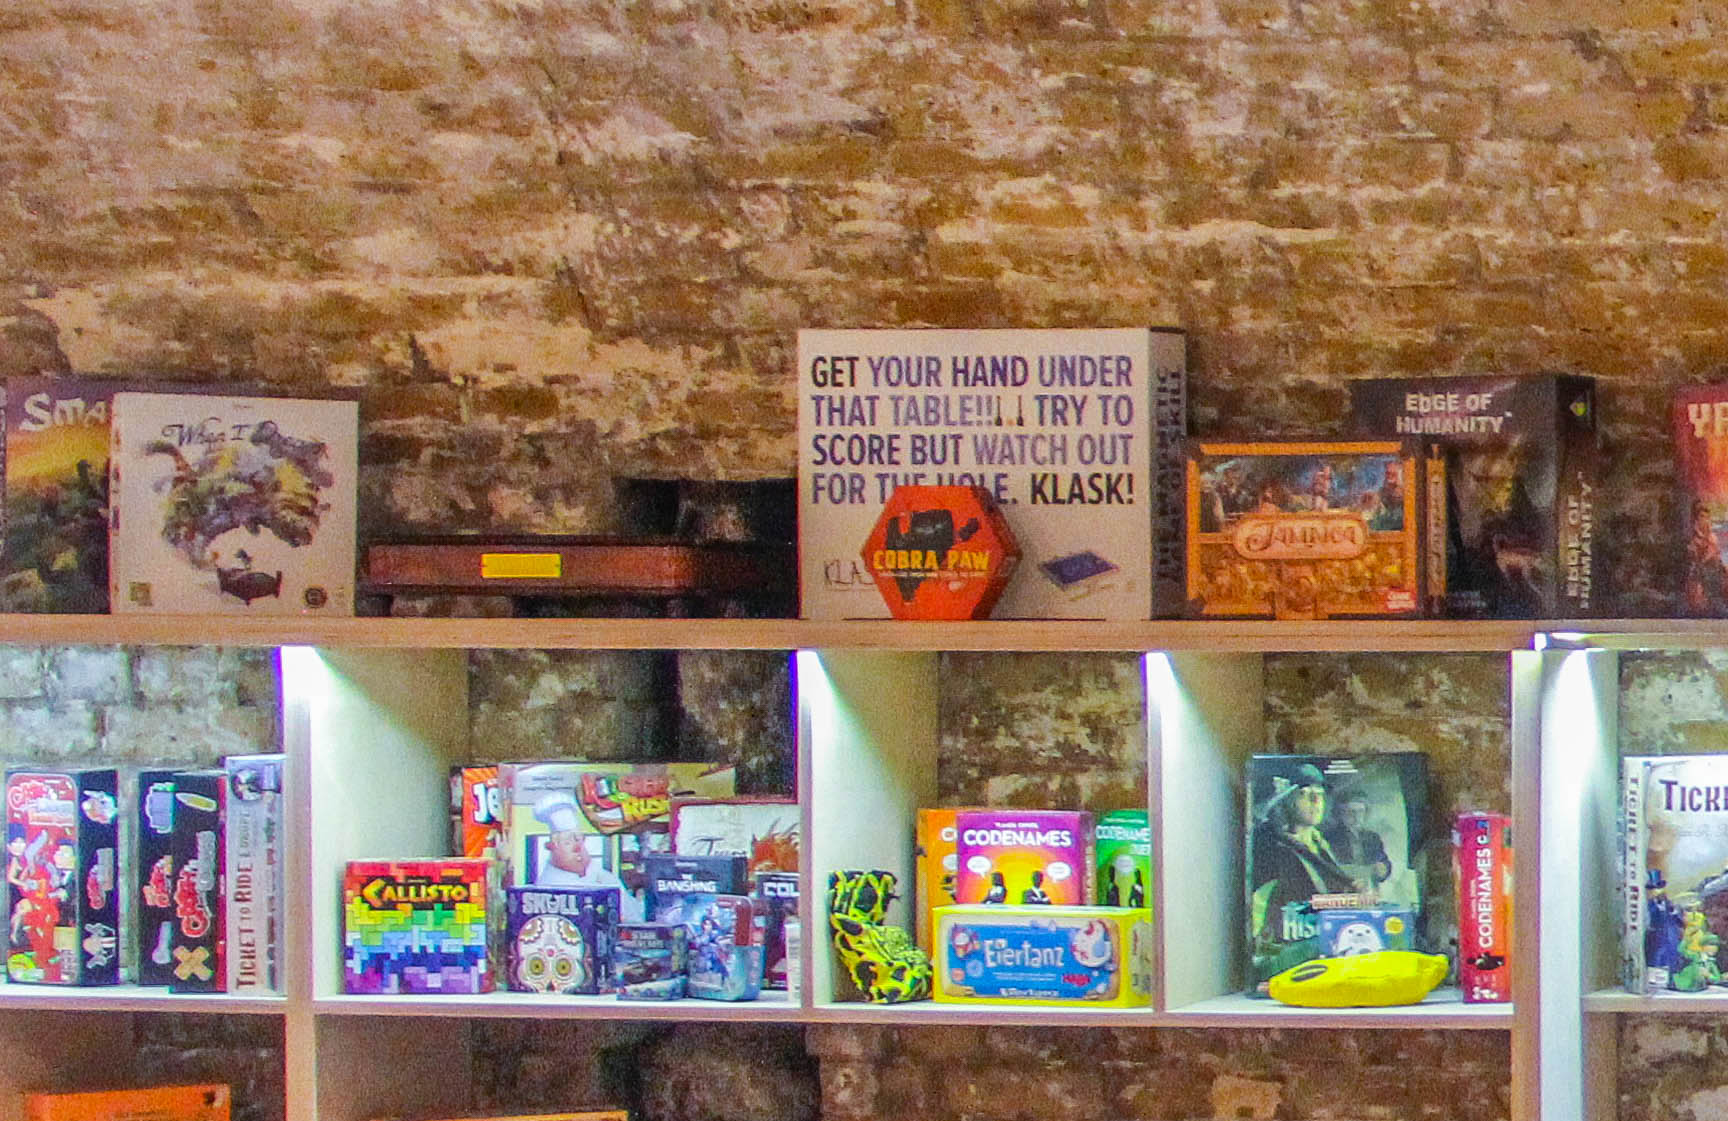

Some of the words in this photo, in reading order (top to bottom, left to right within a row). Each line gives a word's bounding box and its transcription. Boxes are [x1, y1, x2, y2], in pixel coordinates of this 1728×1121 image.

[812, 356, 858, 387] GET
[868, 356, 942, 387] YOUR
[952, 356, 1028, 387] HAND
[1038, 356, 1132, 387] UNDER
[811, 395, 879, 426] THAT
[1035, 395, 1086, 426] TRY
[1097, 395, 1133, 426] TO
[1405, 393, 1459, 414] EDGE
[1465, 393, 1493, 412] OF
[1396, 416, 1504, 435] HUMANITY
[812, 435, 900, 465] SCORE
[911, 435, 963, 465] BUT
[973, 435, 1067, 465] WATCH
[1078, 435, 1133, 465] OUT
[812, 474, 874, 505] FOR
[1030, 474, 1134, 505] KLASK!
[873, 550, 938, 570] COBRA
[948, 551, 989, 570] PAW
[963, 829, 1073, 847] CODENAMES
[234, 863, 254, 904] RIDE
[361, 878, 469, 903] CALLISTO
[656, 880, 718, 894] BANISHING
[521, 893, 581, 914] SKULL
[1477, 848, 1493, 949] CODENAMES
[240, 906, 251, 921] TO
[236, 926, 257, 990] TICKET
